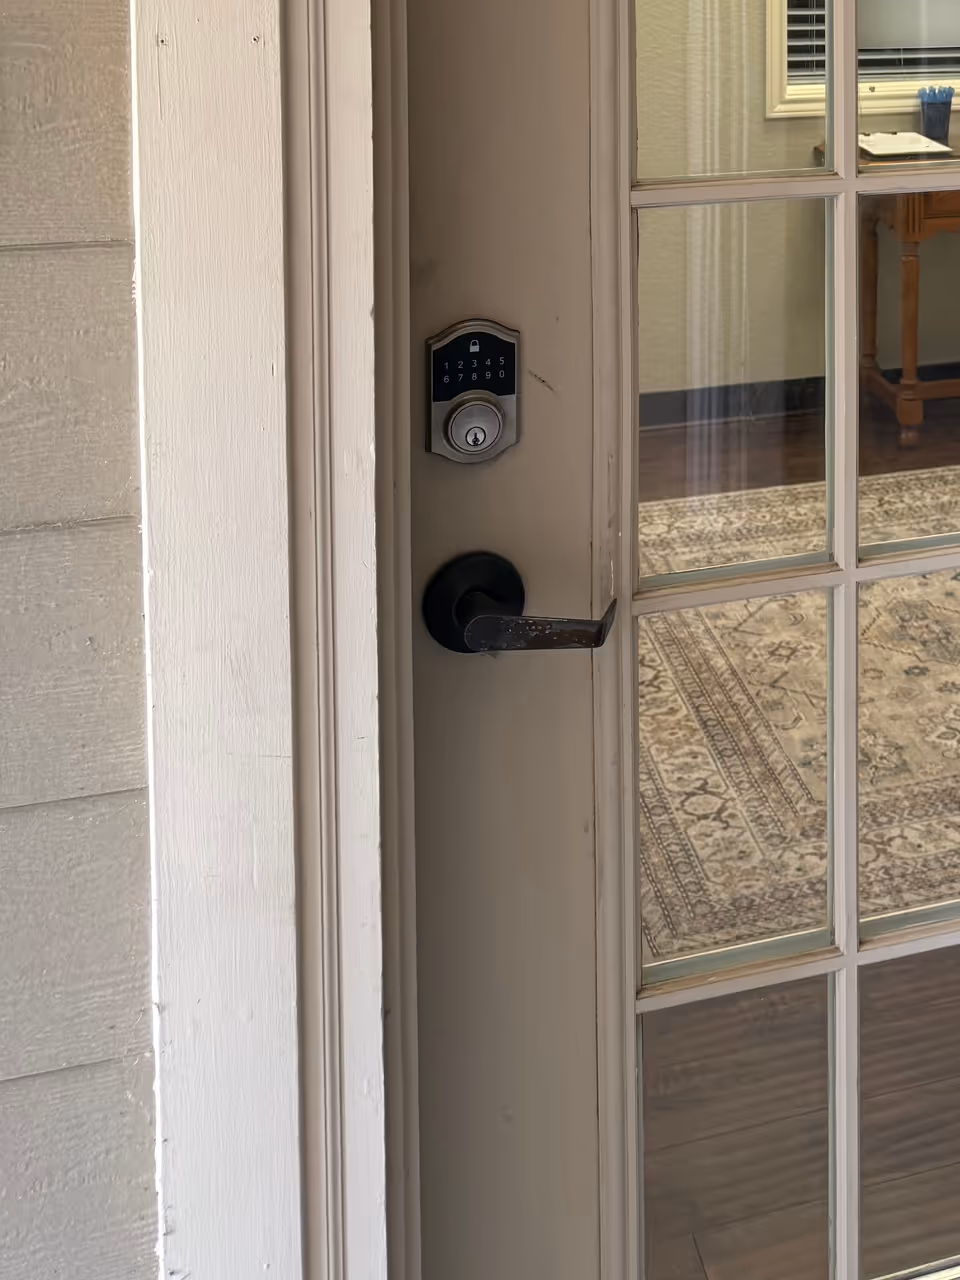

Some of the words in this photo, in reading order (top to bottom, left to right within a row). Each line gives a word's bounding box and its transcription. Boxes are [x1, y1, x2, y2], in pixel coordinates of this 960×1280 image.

[444, 362, 449, 370] 1
[458, 361, 464, 369] 2
[485, 358, 491, 366] 4
[499, 357, 505, 365] 5
[444, 375, 449, 383] 6
[458, 374, 463, 382] 7
[485, 371, 491, 379] 9
[499, 370, 504, 378] 0
